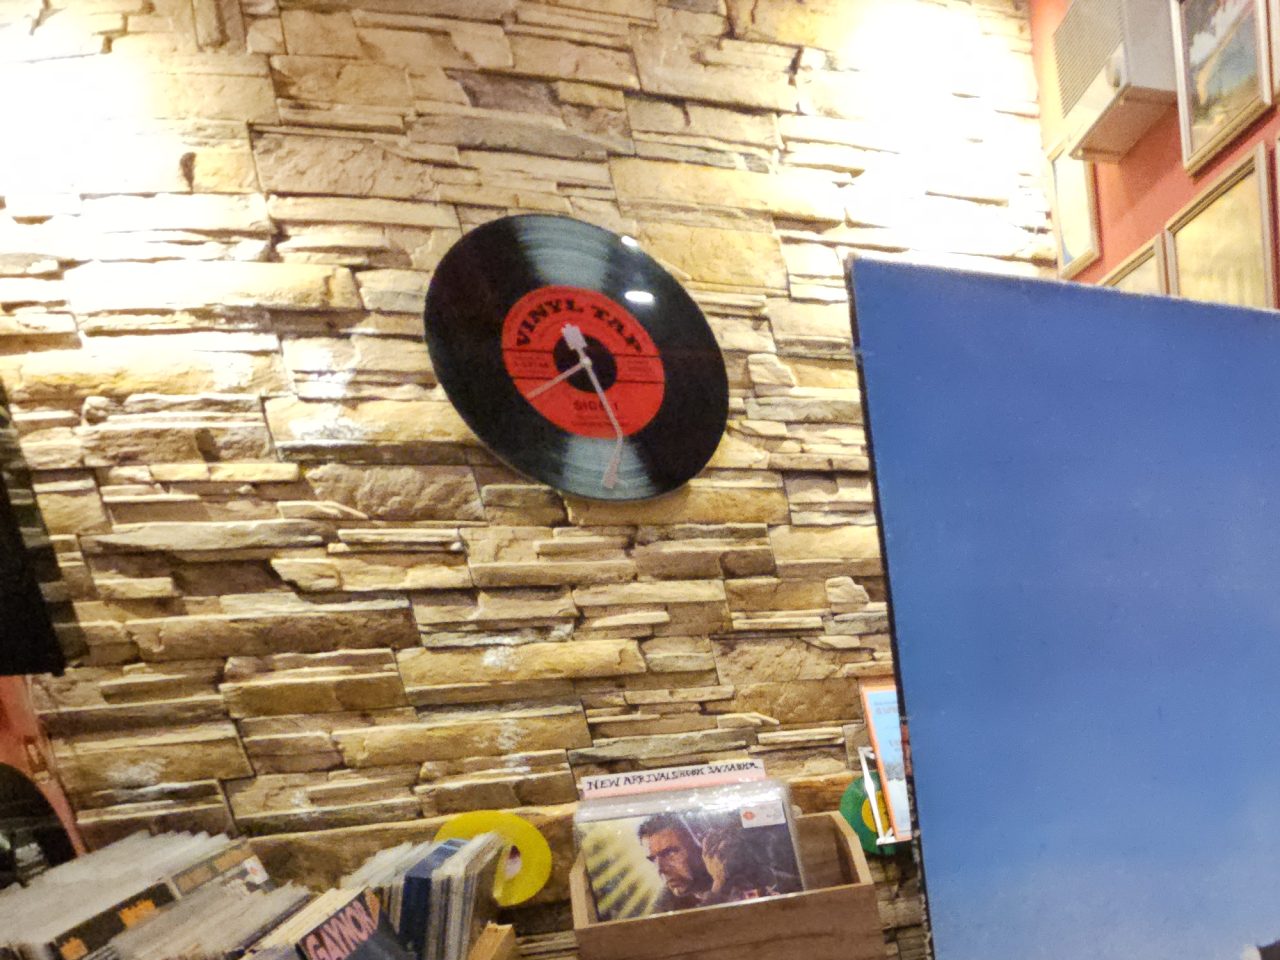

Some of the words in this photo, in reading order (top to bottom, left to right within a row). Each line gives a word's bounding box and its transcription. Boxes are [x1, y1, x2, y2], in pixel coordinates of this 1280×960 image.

[516, 299, 584, 346] VINYL
[590, 305, 641, 353] TAP
[587, 776, 620, 791] NEW
